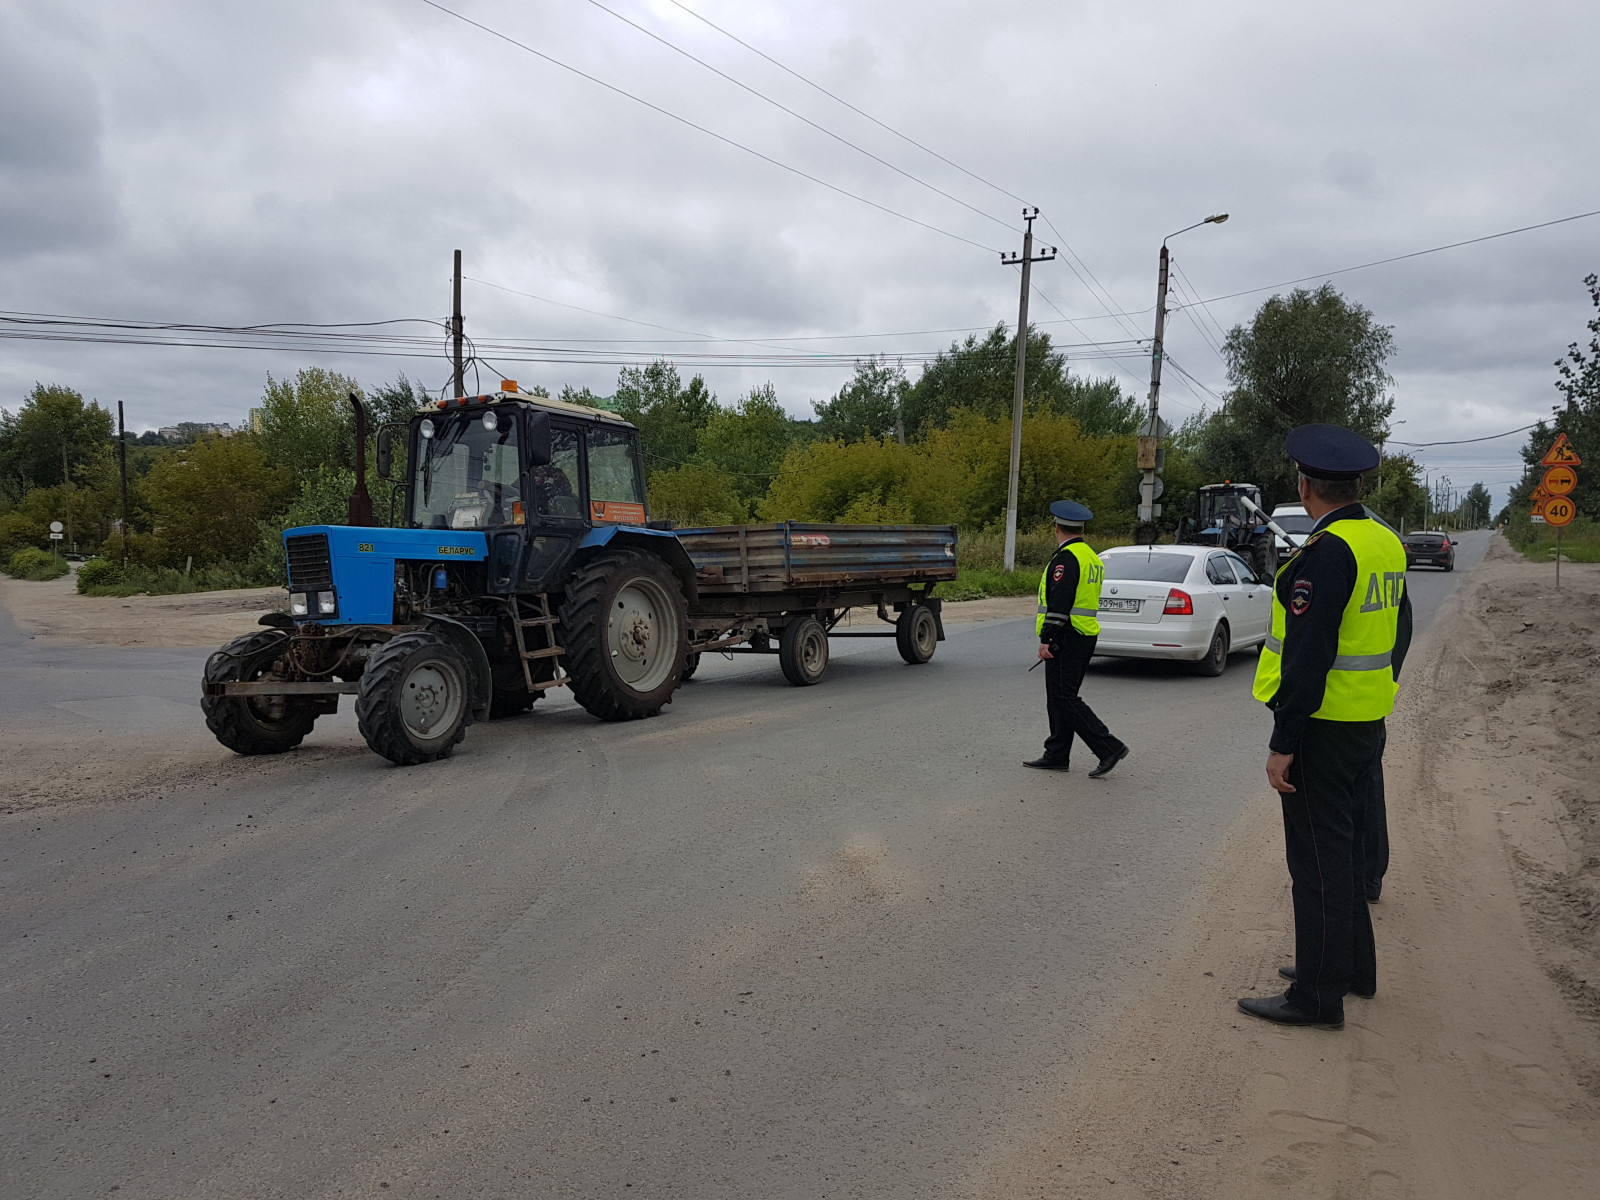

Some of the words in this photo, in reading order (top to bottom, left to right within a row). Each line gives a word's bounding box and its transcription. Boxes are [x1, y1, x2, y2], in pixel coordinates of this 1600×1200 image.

[1549, 505, 1568, 517] 40
[359, 543, 374, 552] 82.1
[438, 546, 475, 555] БЕЛАРУС
[1360, 571, 1404, 613] ДПС
